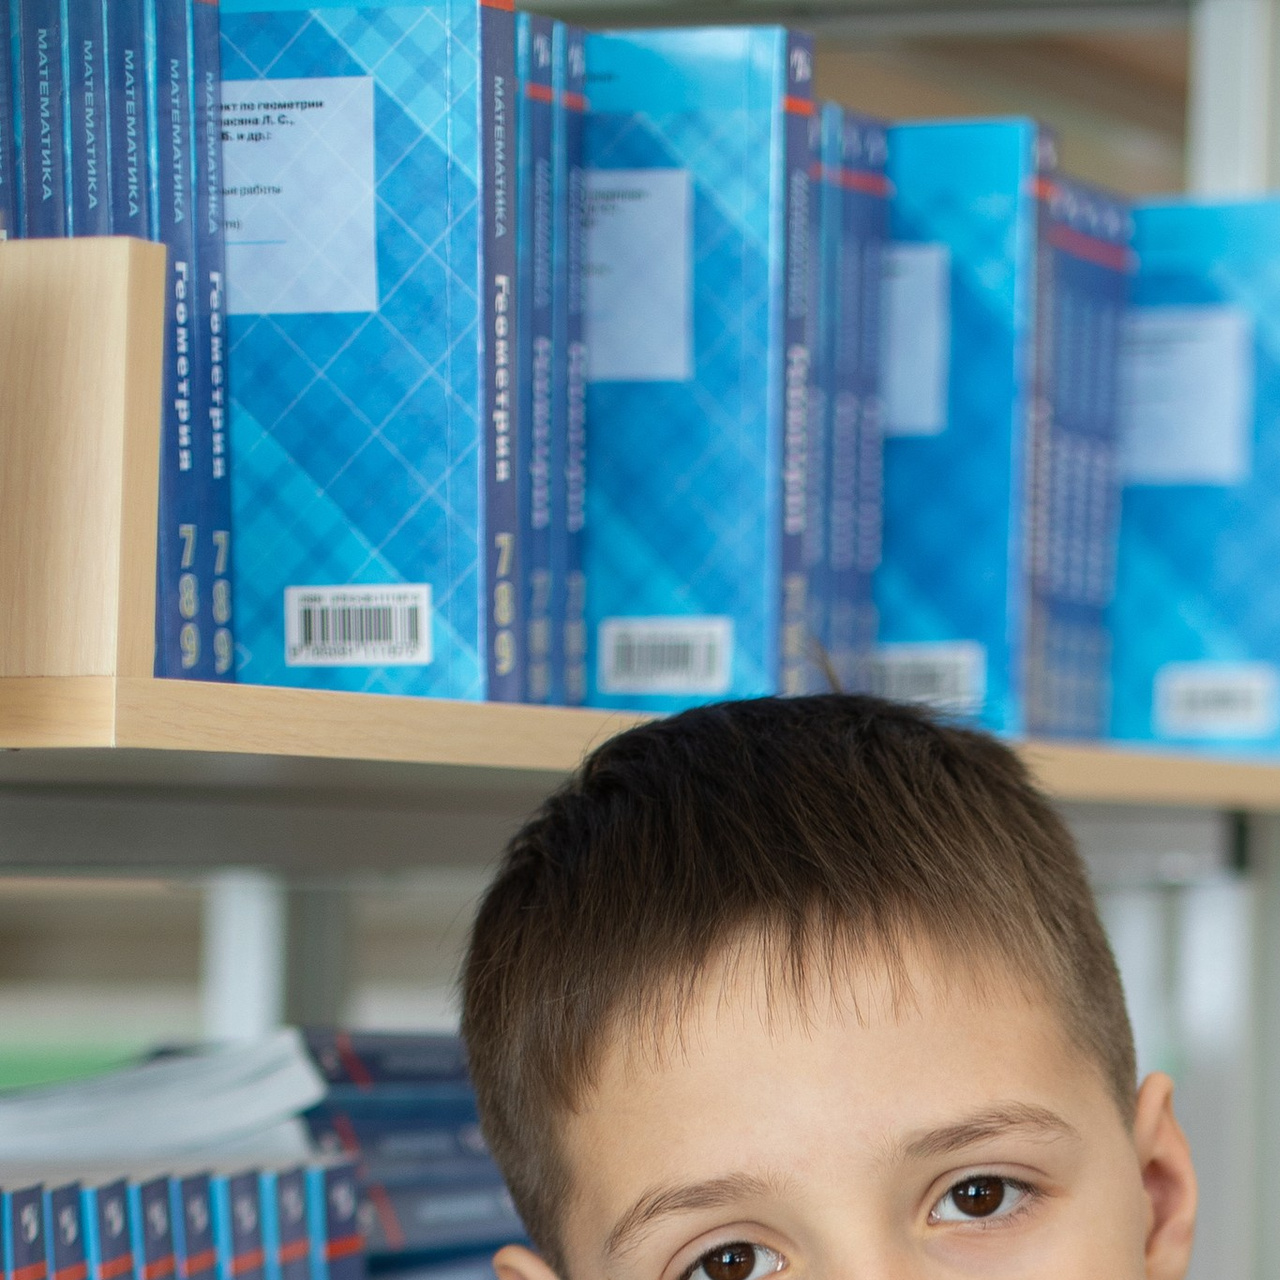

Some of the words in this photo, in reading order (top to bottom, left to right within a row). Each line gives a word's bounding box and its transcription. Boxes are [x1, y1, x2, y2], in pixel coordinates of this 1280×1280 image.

[38, 28, 52, 201] МАТЕМАТИКА
[84, 40, 98, 210] МАТЕМАТИКА
[124, 49, 140, 218] МАТЕМАТИКА
[170, 58, 186, 224] МАТЕМАТИКА
[206, 72, 219, 234] МАТЕМАТИКА
[257, 101, 324, 111] геометрии
[494, 75, 507, 239] МАТЕМАТИКА
[174, 261, 194, 471] Геометрия
[209, 271, 227, 479] Геометрия
[492, 274, 512, 482] Геометрия
